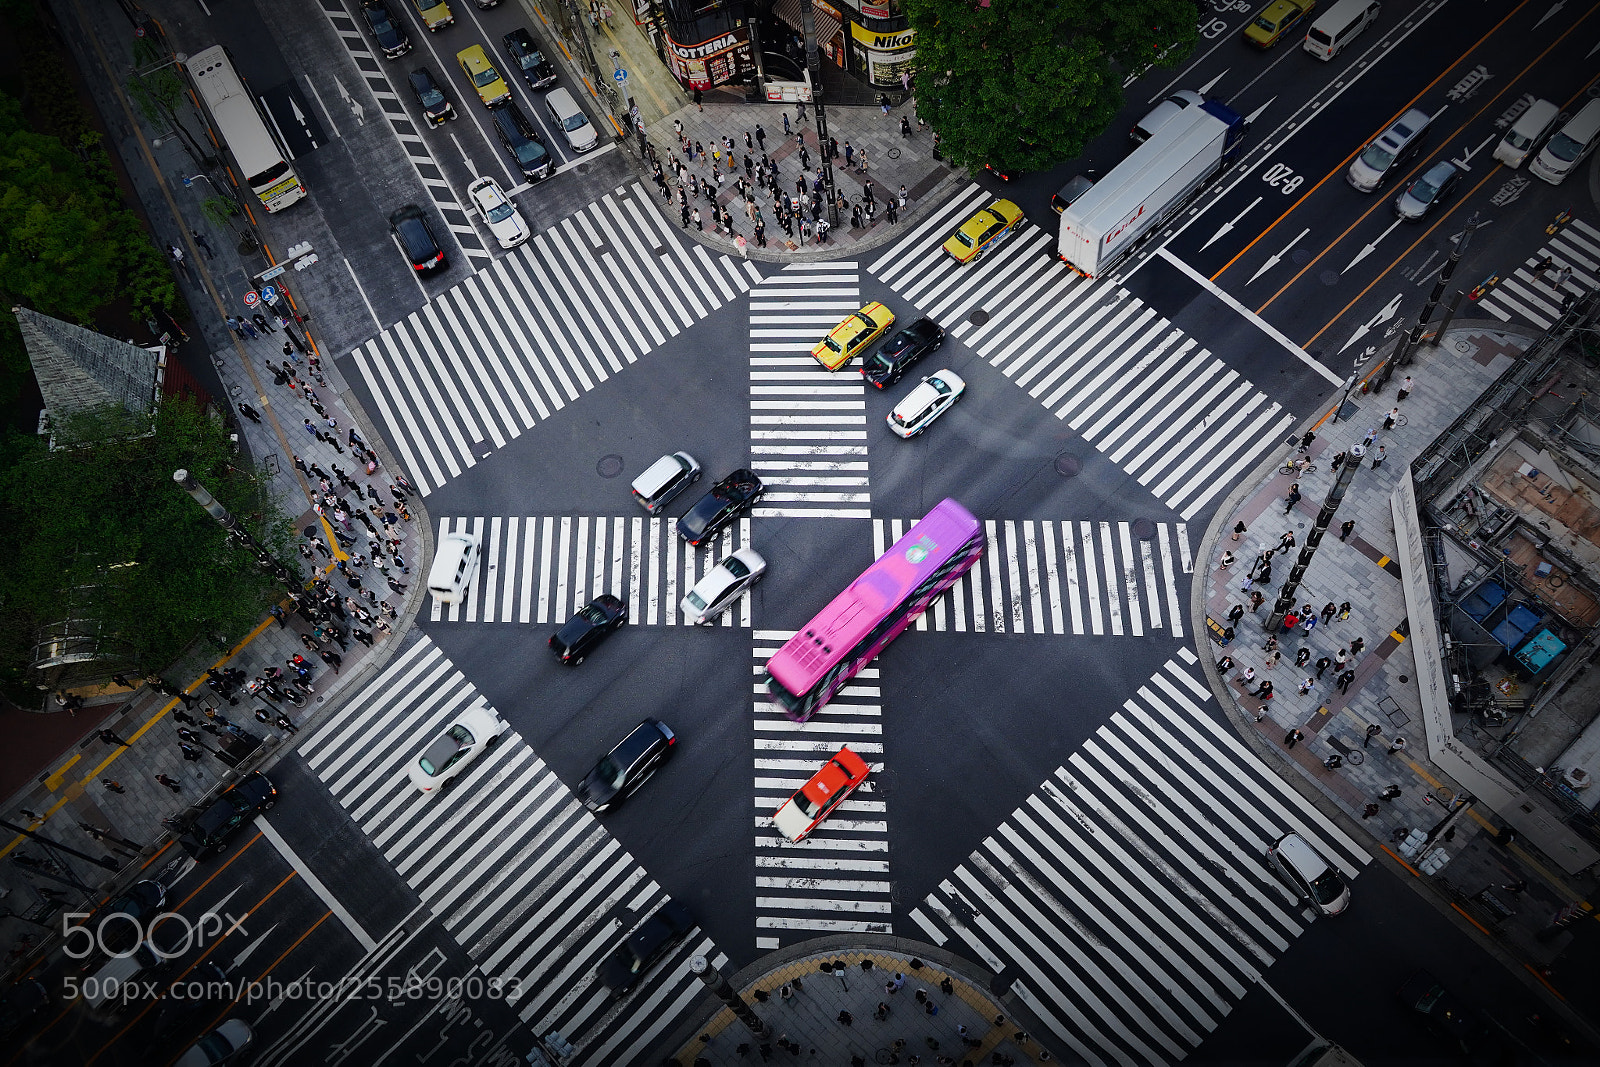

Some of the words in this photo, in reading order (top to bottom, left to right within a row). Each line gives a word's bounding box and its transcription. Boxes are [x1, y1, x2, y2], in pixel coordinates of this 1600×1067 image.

[672, 34, 738, 59] LOTTERIA
[874, 31, 919, 48] Niko
[1262, 162, 1305, 195] 8-20
